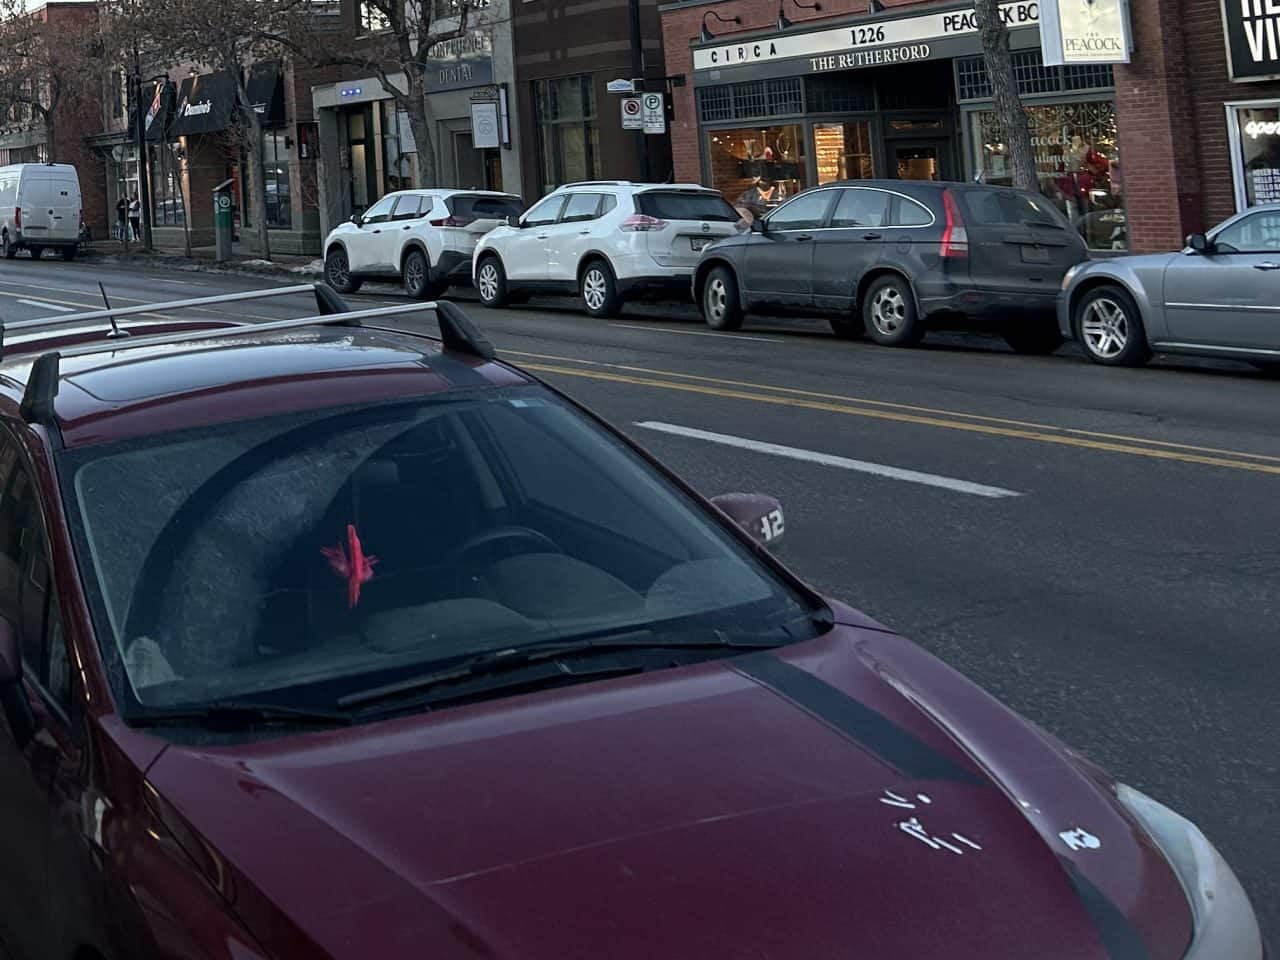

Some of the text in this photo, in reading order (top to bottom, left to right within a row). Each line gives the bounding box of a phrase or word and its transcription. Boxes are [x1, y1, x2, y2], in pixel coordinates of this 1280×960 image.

[944, 6, 1013, 33] PEACCK
[850, 25, 885, 45] 1226
[1064, 37, 1122, 51] PEACOCK
[1243, 17, 1280, 62] VI
[711, 42, 777, 63] CIRCA
[810, 44, 930, 71] THE RUTHERFORD
